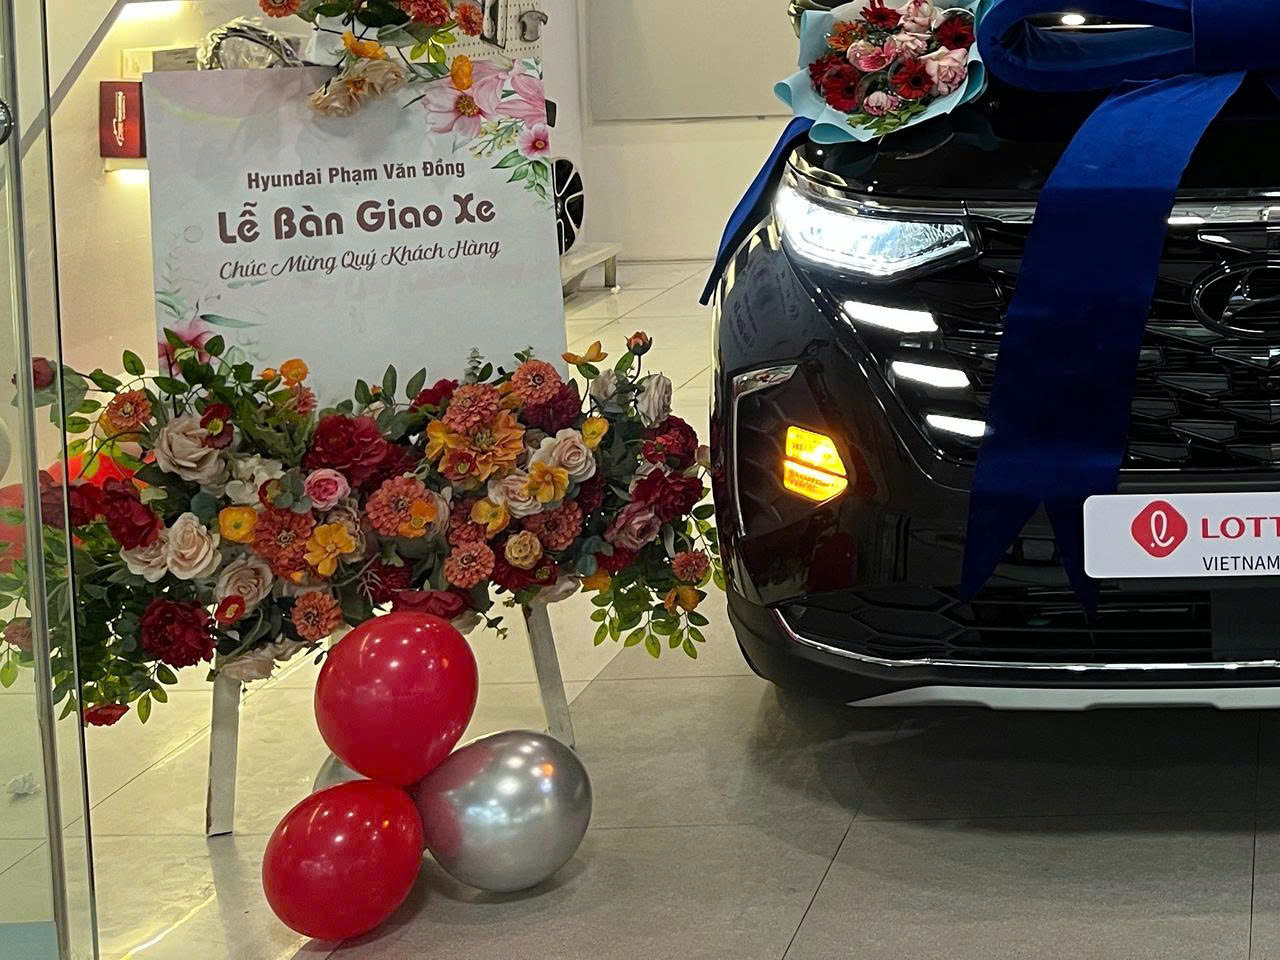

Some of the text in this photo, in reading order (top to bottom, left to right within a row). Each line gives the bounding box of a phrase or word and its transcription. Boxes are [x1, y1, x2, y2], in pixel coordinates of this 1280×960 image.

[247, 158, 465, 192] Hyundai Phạm Văn Đồng
[217, 193, 496, 244] Lễ Bàn Giao Xe
[219, 240, 501, 281] Chúc Mừng Quý Khách Hàng
[1202, 554, 1280, 571] VIETNAM
